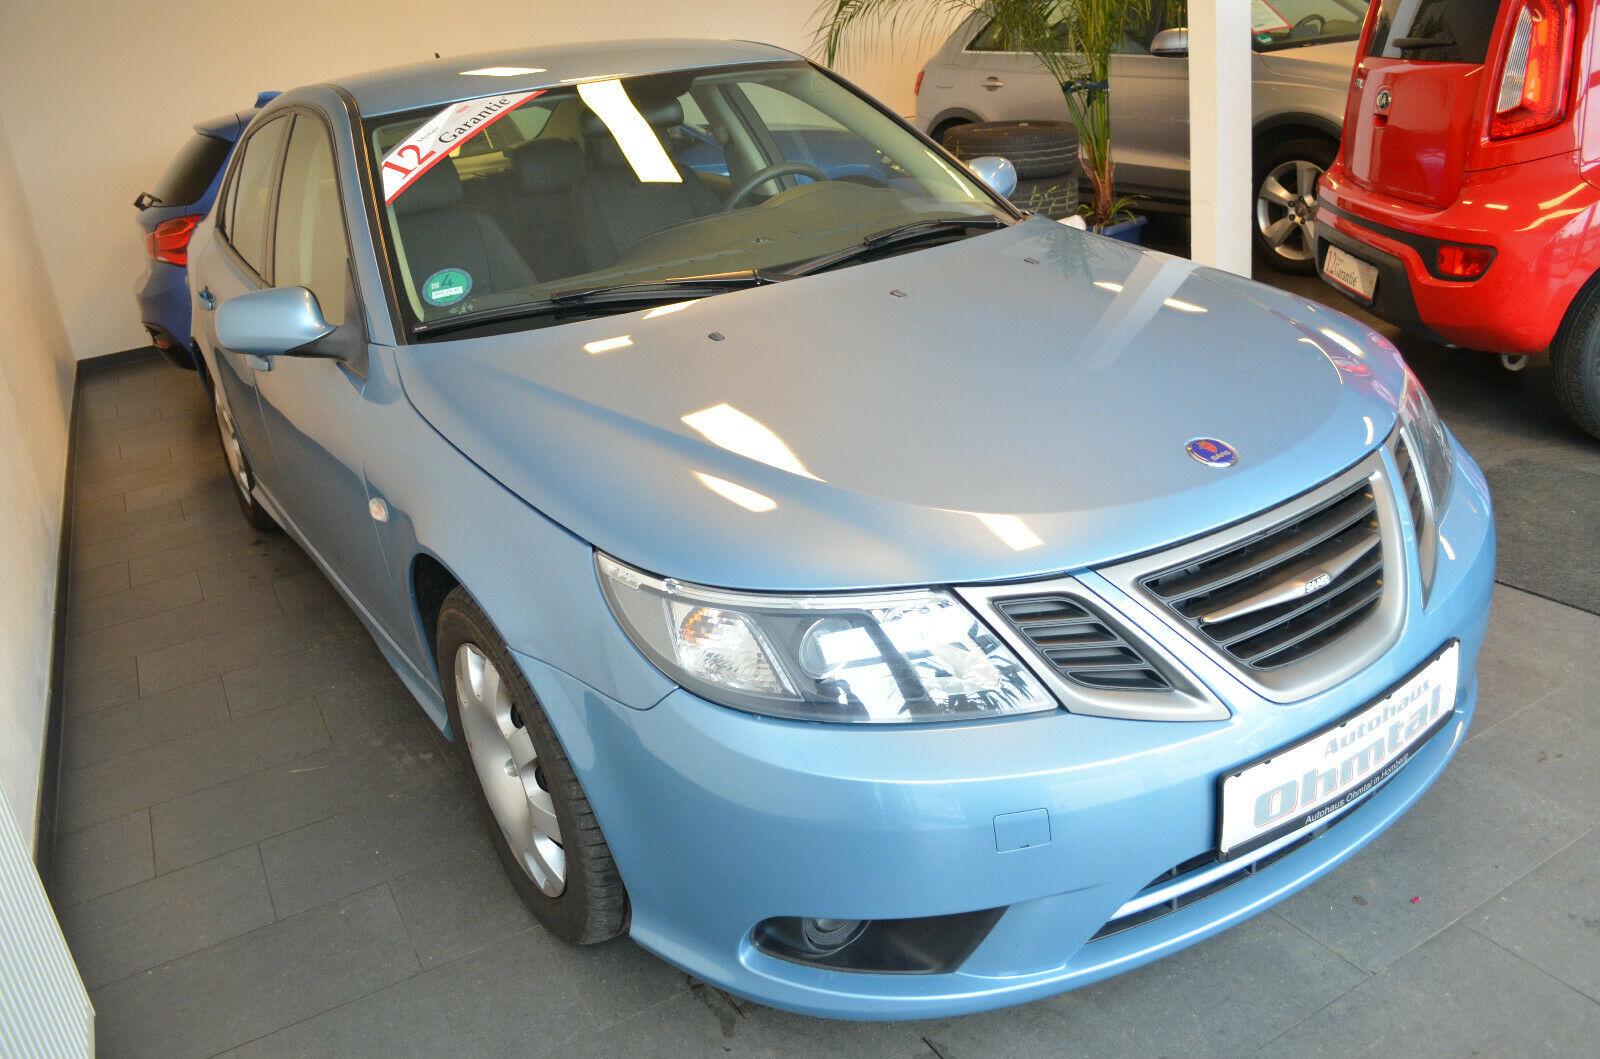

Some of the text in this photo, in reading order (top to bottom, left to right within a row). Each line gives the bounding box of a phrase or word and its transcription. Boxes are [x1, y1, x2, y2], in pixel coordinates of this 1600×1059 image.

[438, 97, 511, 144] Garantie
[382, 144, 436, 179] 12
[1324, 679, 1430, 759] Autohaus
[1253, 684, 1442, 829] ohmtal
[1304, 799, 1345, 826] Autohaus
[1346, 780, 1373, 803] Ohmtal
[1373, 775, 1381, 785] in
